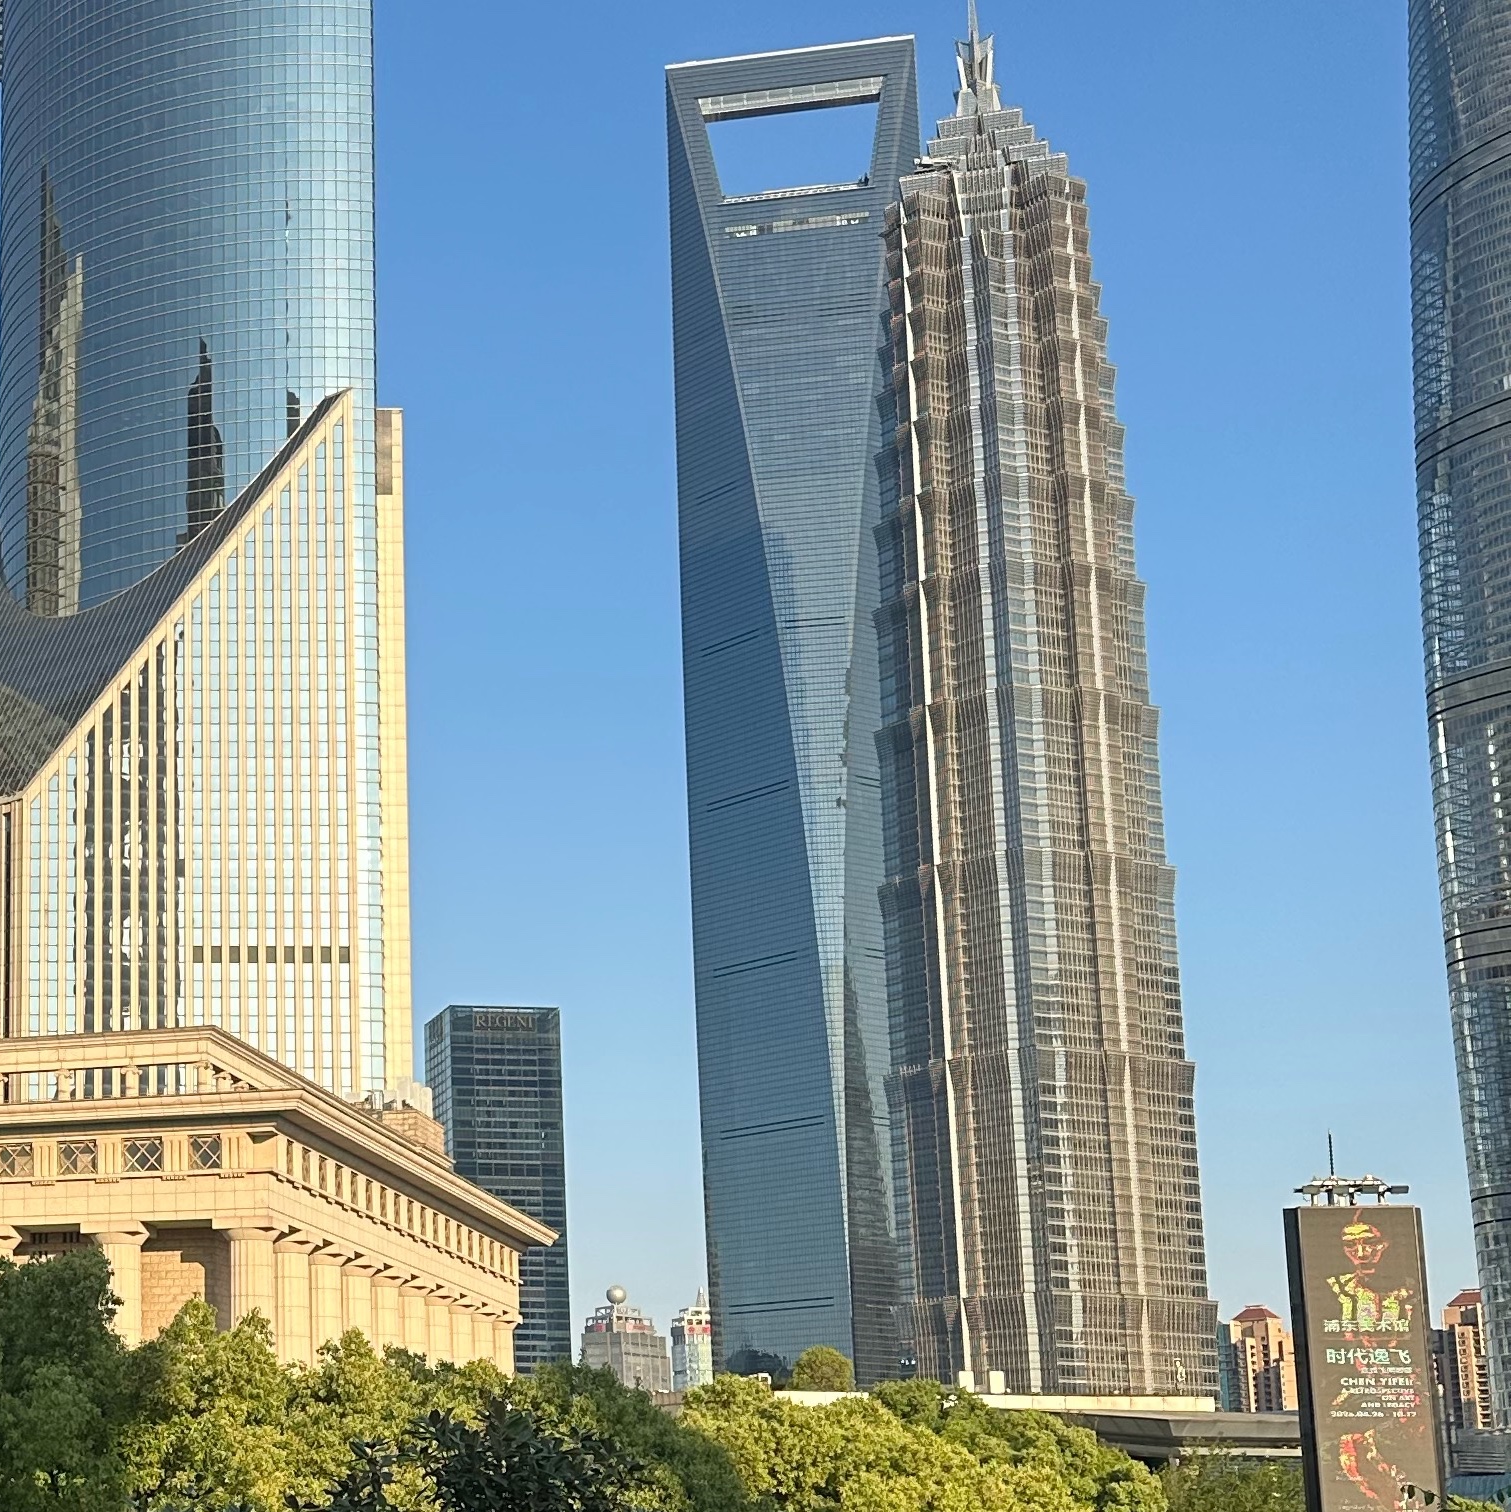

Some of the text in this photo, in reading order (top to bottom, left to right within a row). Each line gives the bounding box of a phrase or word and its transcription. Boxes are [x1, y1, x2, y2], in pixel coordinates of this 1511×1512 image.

[475, 1014, 533, 1028] REGENT
[1326, 1348, 1412, 1365] 时代逸飞
[1340, 1377, 1375, 1386] CHEN
